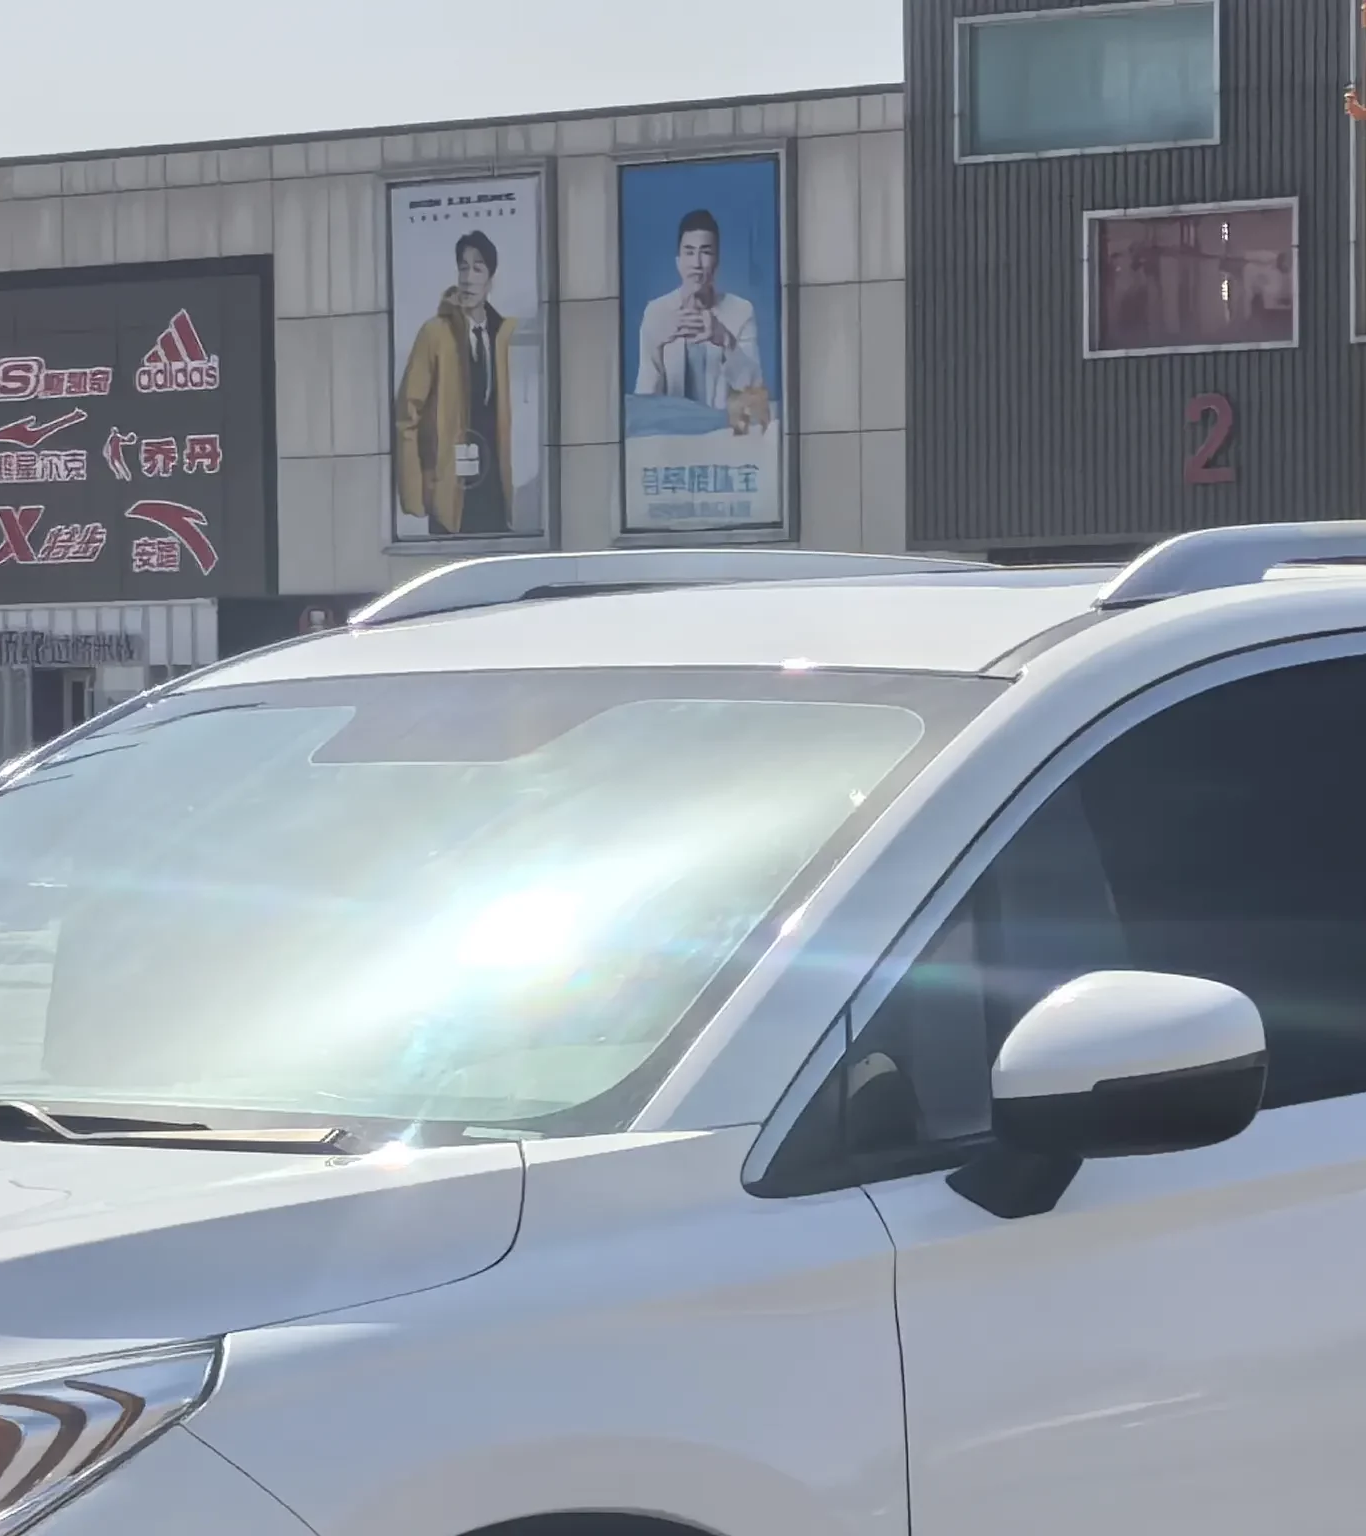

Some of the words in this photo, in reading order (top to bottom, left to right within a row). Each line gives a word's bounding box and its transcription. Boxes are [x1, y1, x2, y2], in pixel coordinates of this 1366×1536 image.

[137, 358, 219, 392] adidas
[140, 434, 223, 478] 乔丹
[1185, 392, 1235, 484] 2
[133, 537, 181, 573] 安踏
